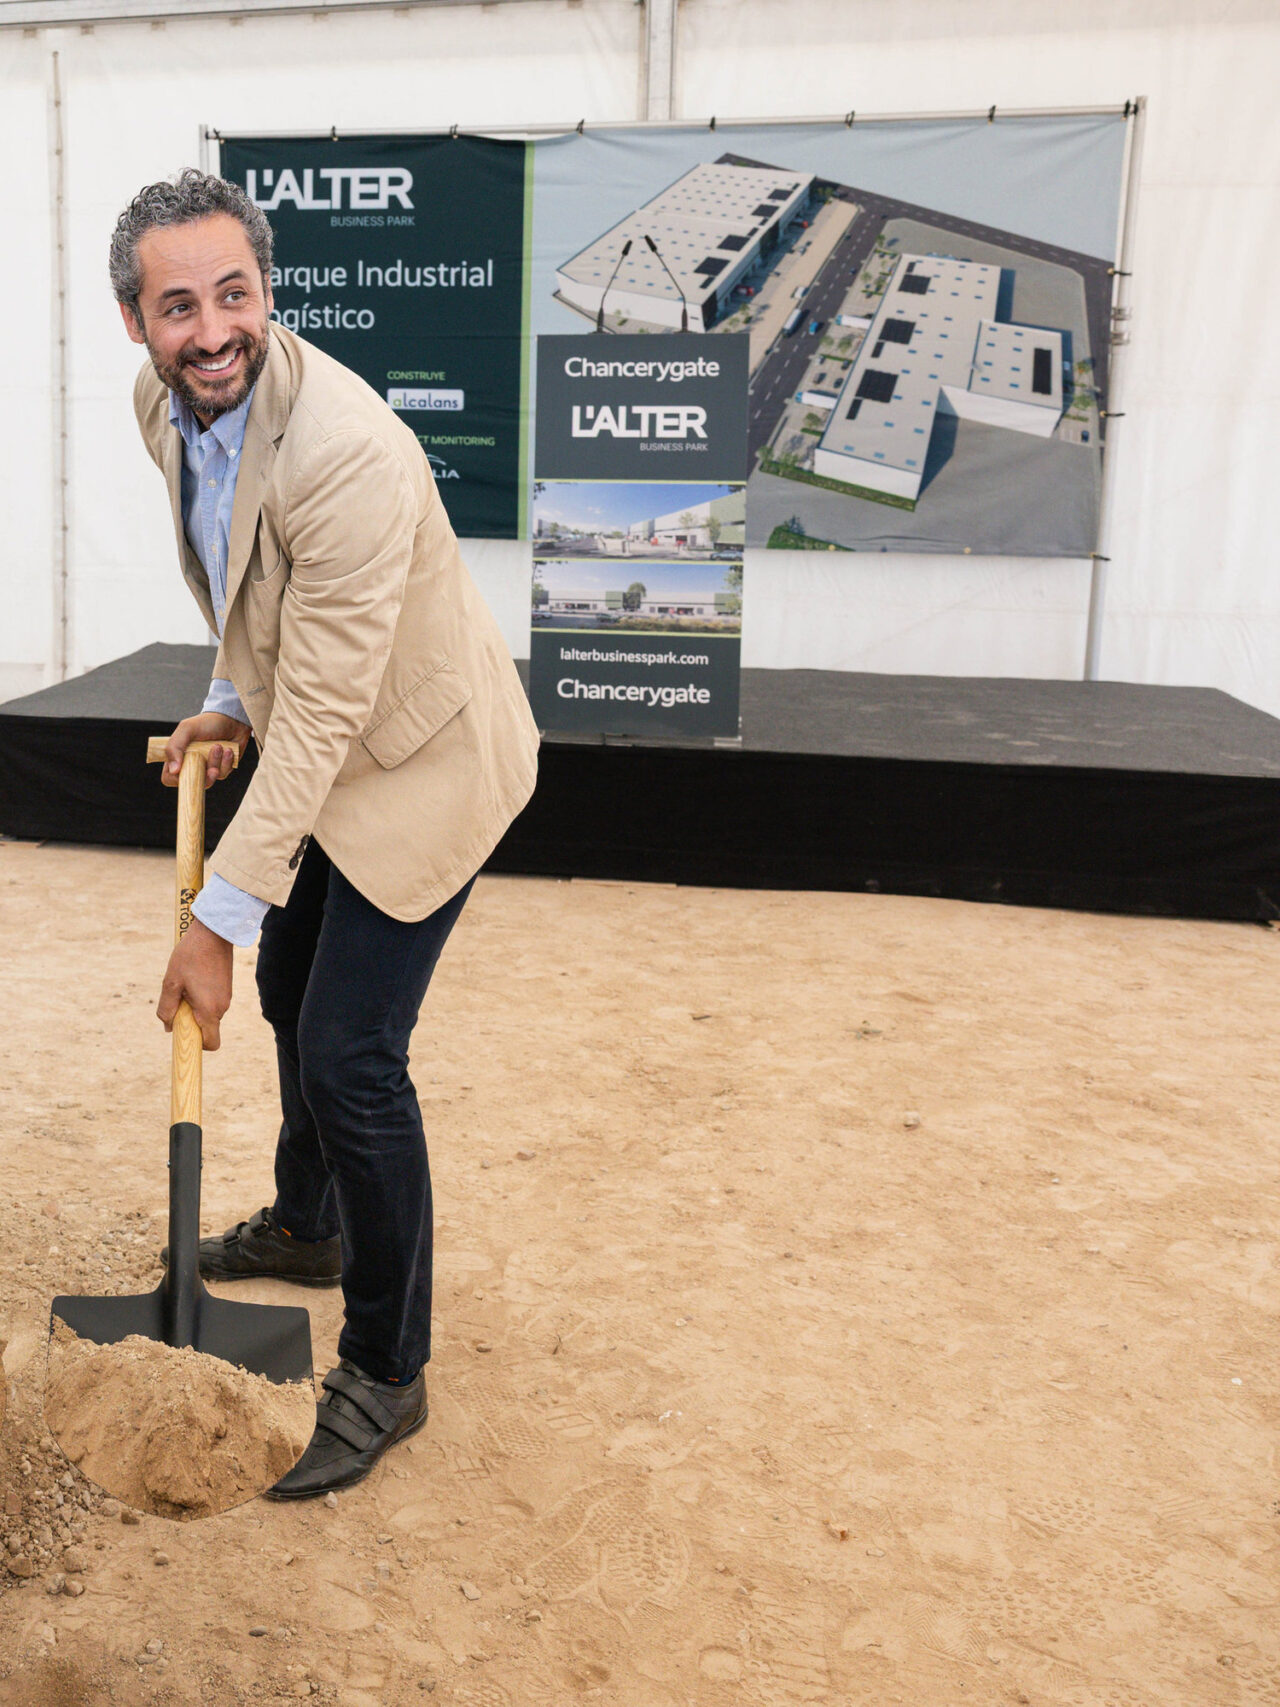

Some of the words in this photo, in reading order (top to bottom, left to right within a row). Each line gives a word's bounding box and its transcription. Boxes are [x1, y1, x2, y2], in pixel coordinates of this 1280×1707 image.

[246, 167, 415, 210] L'ALTER
[331, 216, 384, 226] BUSINESS
[387, 216, 415, 226] PARK
[270, 265, 348, 293] arque
[357, 259, 494, 287] Industrial
[270, 302, 375, 334] ogístico
[387, 371, 446, 381] CONSTRUYE
[564, 357, 720, 382] Chancerygate
[393, 392, 459, 409] alcalans
[572, 405, 708, 438] L'ALTER
[431, 435, 496, 446] MONITORING
[640, 442, 683, 451] BUSINESS
[685, 442, 708, 451] PARK
[560, 647, 709, 666] lalterbusinesspark.com
[557, 678, 711, 707] Chancerygate
[180, 905, 190, 942] TOOL
